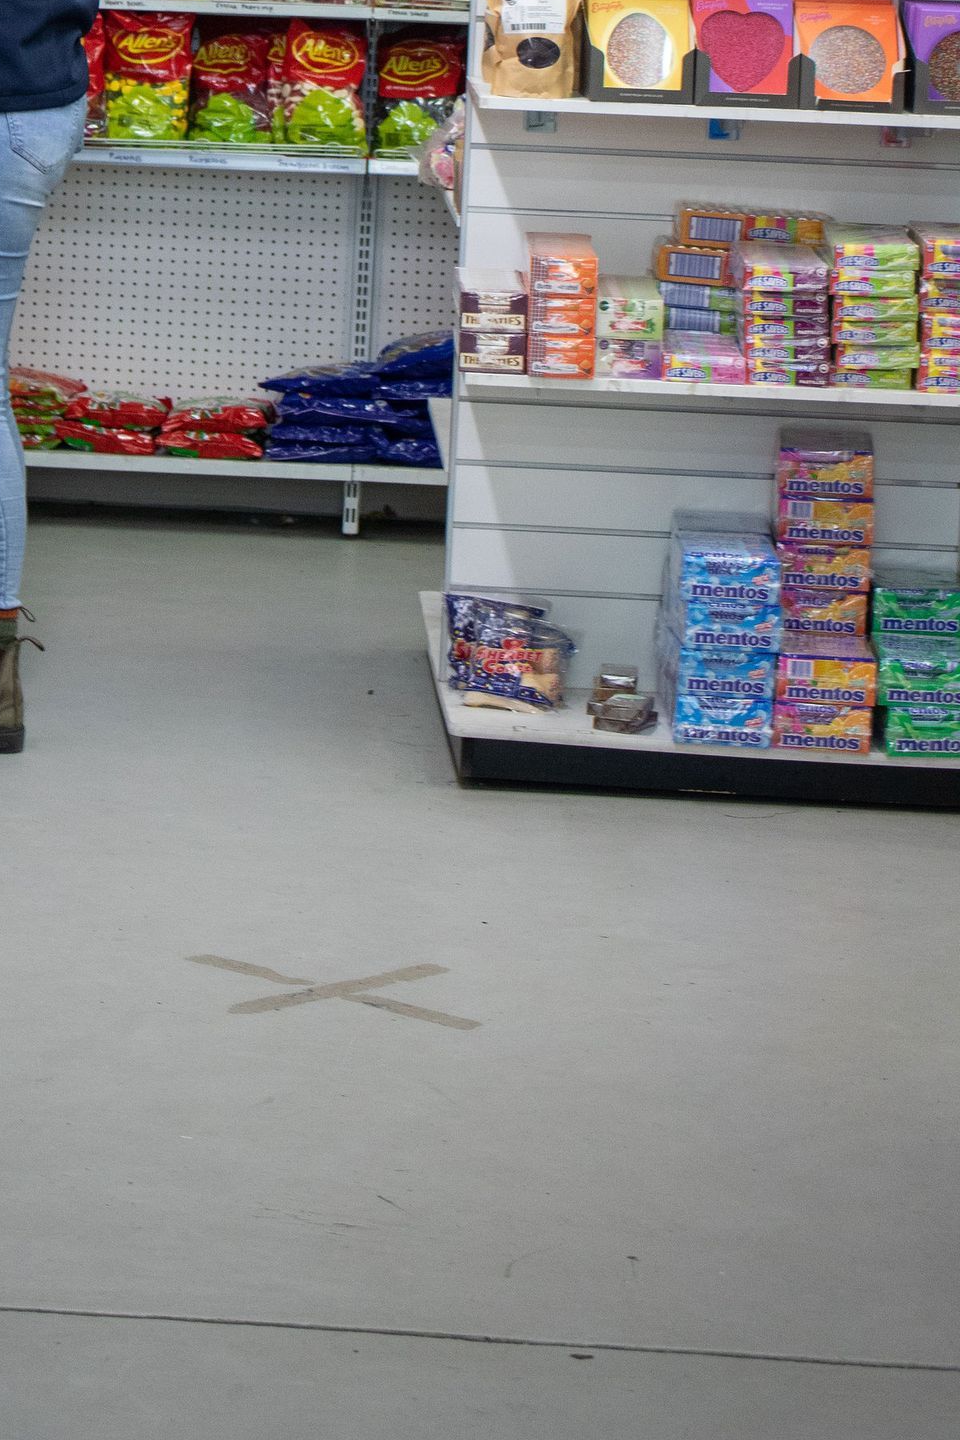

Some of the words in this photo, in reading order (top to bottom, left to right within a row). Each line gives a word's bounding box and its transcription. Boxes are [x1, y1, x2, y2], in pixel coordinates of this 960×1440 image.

[117, 32, 176, 52] Allen's
[385, 56, 442, 74] Allen's
[749, 228, 764, 237] LIFE
[765, 229, 791, 240] SAVERS
[839, 258, 854, 266] LIFE
[928, 264, 942, 272] LIFE
[749, 326, 763, 334] LIFE
[764, 326, 789, 335] SAVERS
[667, 369, 682, 378] LIFE
[682, 369, 707, 379] SAVERS
[750, 373, 765, 382] LIFE
[765, 373, 790, 382] SAVERS
[788, 478, 864, 494] mentos
[788, 525, 864, 542] mentos
[784, 571, 860, 588] mentos
[691, 583, 769, 601] mentos
[783, 617, 856, 634] mentos
[882, 616, 958, 633] mentos
[694, 630, 772, 648] mentos
[687, 677, 765, 694] mentos
[786, 685, 865, 702] mentos
[782, 733, 860, 750] mentos
[895, 737, 960, 752] mento
